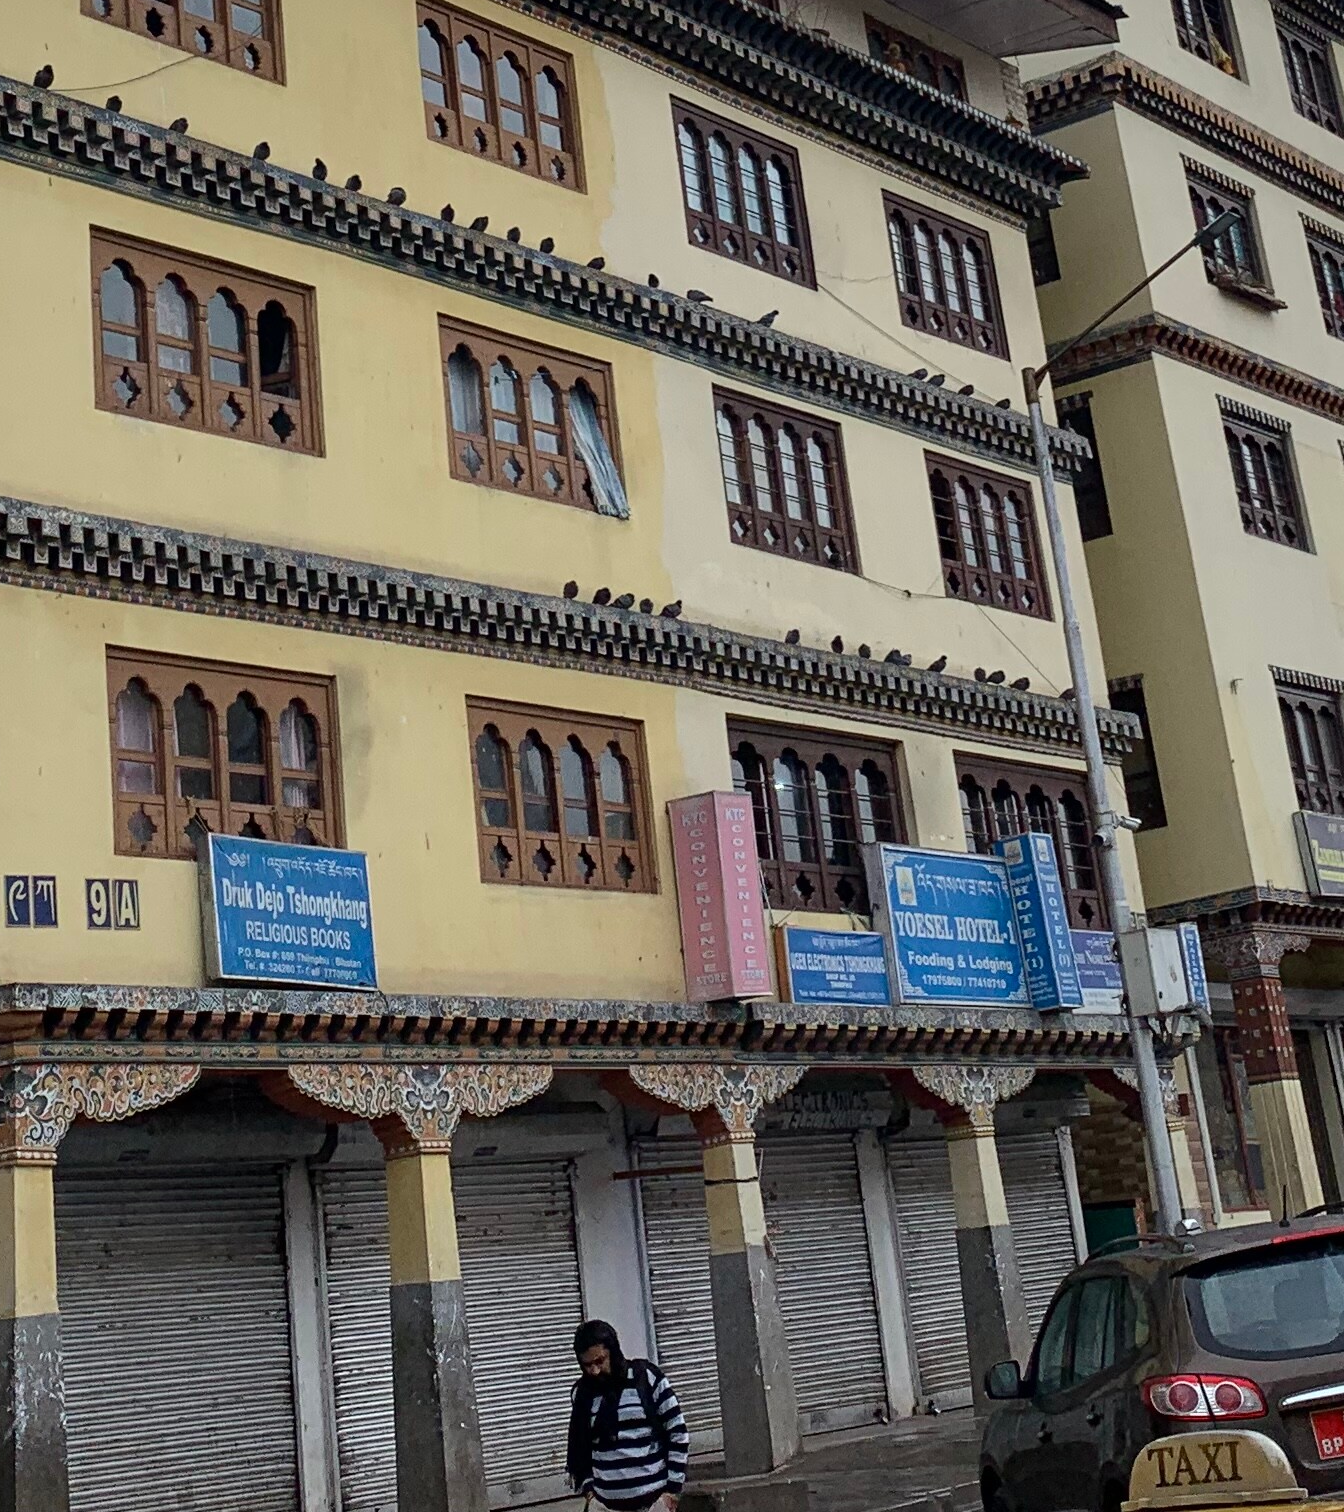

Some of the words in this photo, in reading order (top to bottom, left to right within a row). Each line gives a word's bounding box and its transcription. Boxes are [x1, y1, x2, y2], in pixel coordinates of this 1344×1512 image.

[222, 877, 254, 909] Druk
[256, 881, 285, 920] Dejo
[286, 885, 368, 930] Tshongkhang
[689, 828, 717, 973] CONVENIENCE
[731, 825, 757, 968] CONVENIENCE
[1014, 885, 1038, 953] HOTEL
[1046, 883, 1067, 949] HOTEL
[245, 920, 308, 946] RELIGIOUS
[311, 927, 352, 951] BOOKS
[894, 910, 954, 941] YOESEL
[907, 950, 955, 971] Fooding
[957, 955, 966, 969] &
[969, 955, 1014, 975] Lodging
[1147, 1441, 1244, 1488] TAXI
[1321, 1437, 1344, 1455] BP
